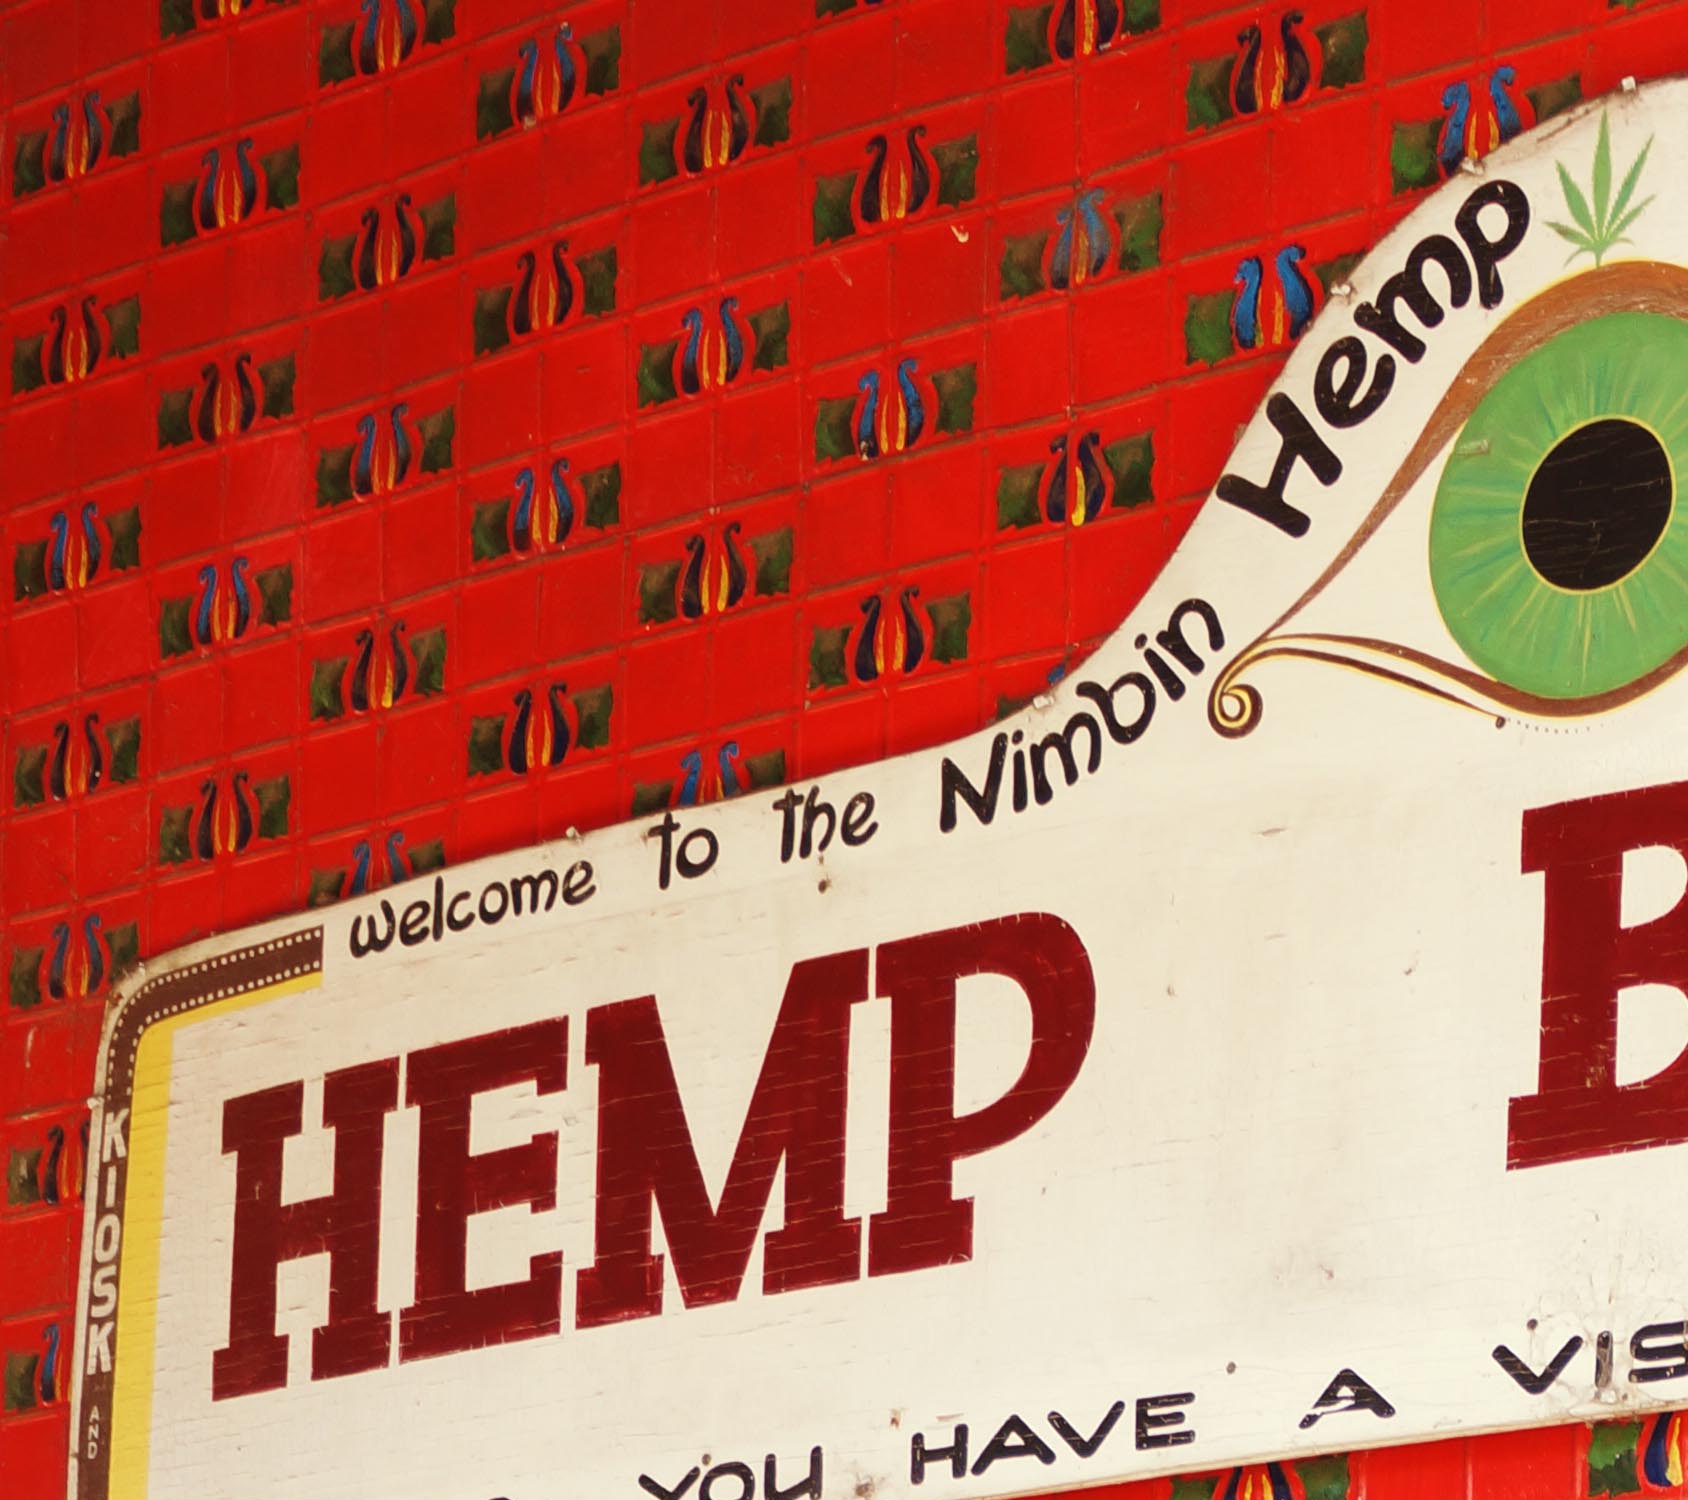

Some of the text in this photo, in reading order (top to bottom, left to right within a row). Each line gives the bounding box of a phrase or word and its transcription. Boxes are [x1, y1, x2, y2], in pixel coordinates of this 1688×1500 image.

[648, 811, 719, 890] to
[940, 597, 1225, 833] Nimbin
[1216, 180, 1530, 538] Hemp
[87, 1108, 130, 1460] KIOSK AND
[212, 911, 1097, 1402] HEMP
[911, 1391, 1197, 1485] HAVE
[1299, 1368, 1395, 1428] A
